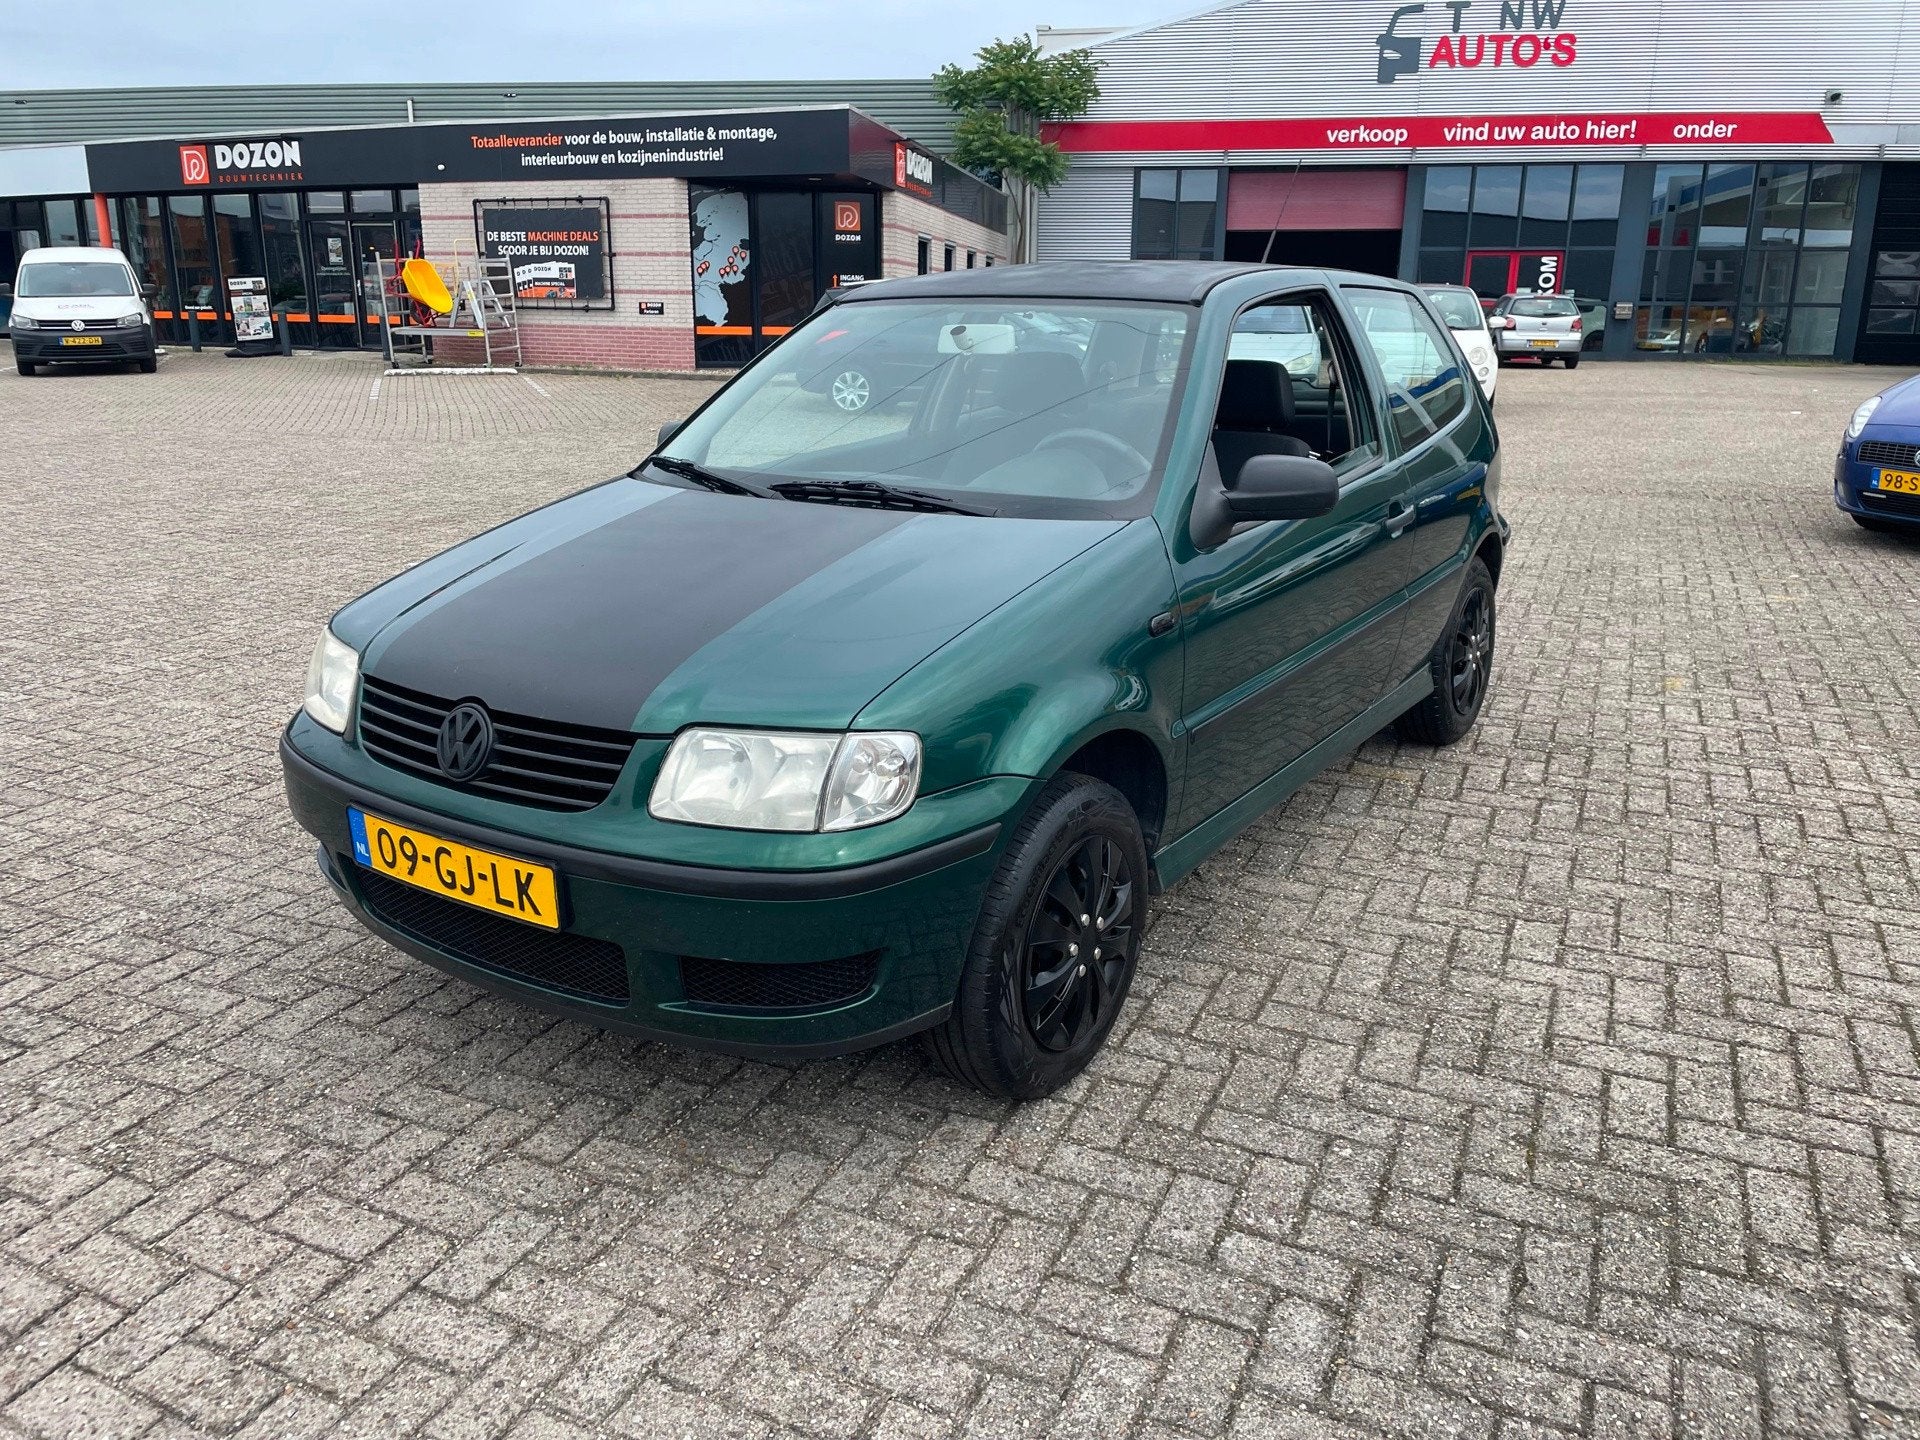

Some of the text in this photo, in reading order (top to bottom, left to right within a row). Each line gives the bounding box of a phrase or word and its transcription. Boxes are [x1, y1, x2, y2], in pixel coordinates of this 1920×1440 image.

[1428, 33, 1577, 68] AUTO'S
[471, 126, 778, 148] Totaalleverancier voor de bouw, installatie & montage,
[1326, 124, 1408, 145] verkoop
[1443, 119, 1637, 141] vind uw auto hier!
[1673, 120, 1738, 138] onder
[214, 141, 301, 169] DOZON
[521, 147, 724, 166] interieurbouw en kozijnenindustrie!
[218, 172, 303, 183] BOUWTECHNIEK
[487, 231, 599, 241] DE BESTE MACHINE DEALS
[498, 245, 589, 255] SCOOR JE BIJ DOZON!
[356, 827, 542, 916] NL 09-GJ-LK
